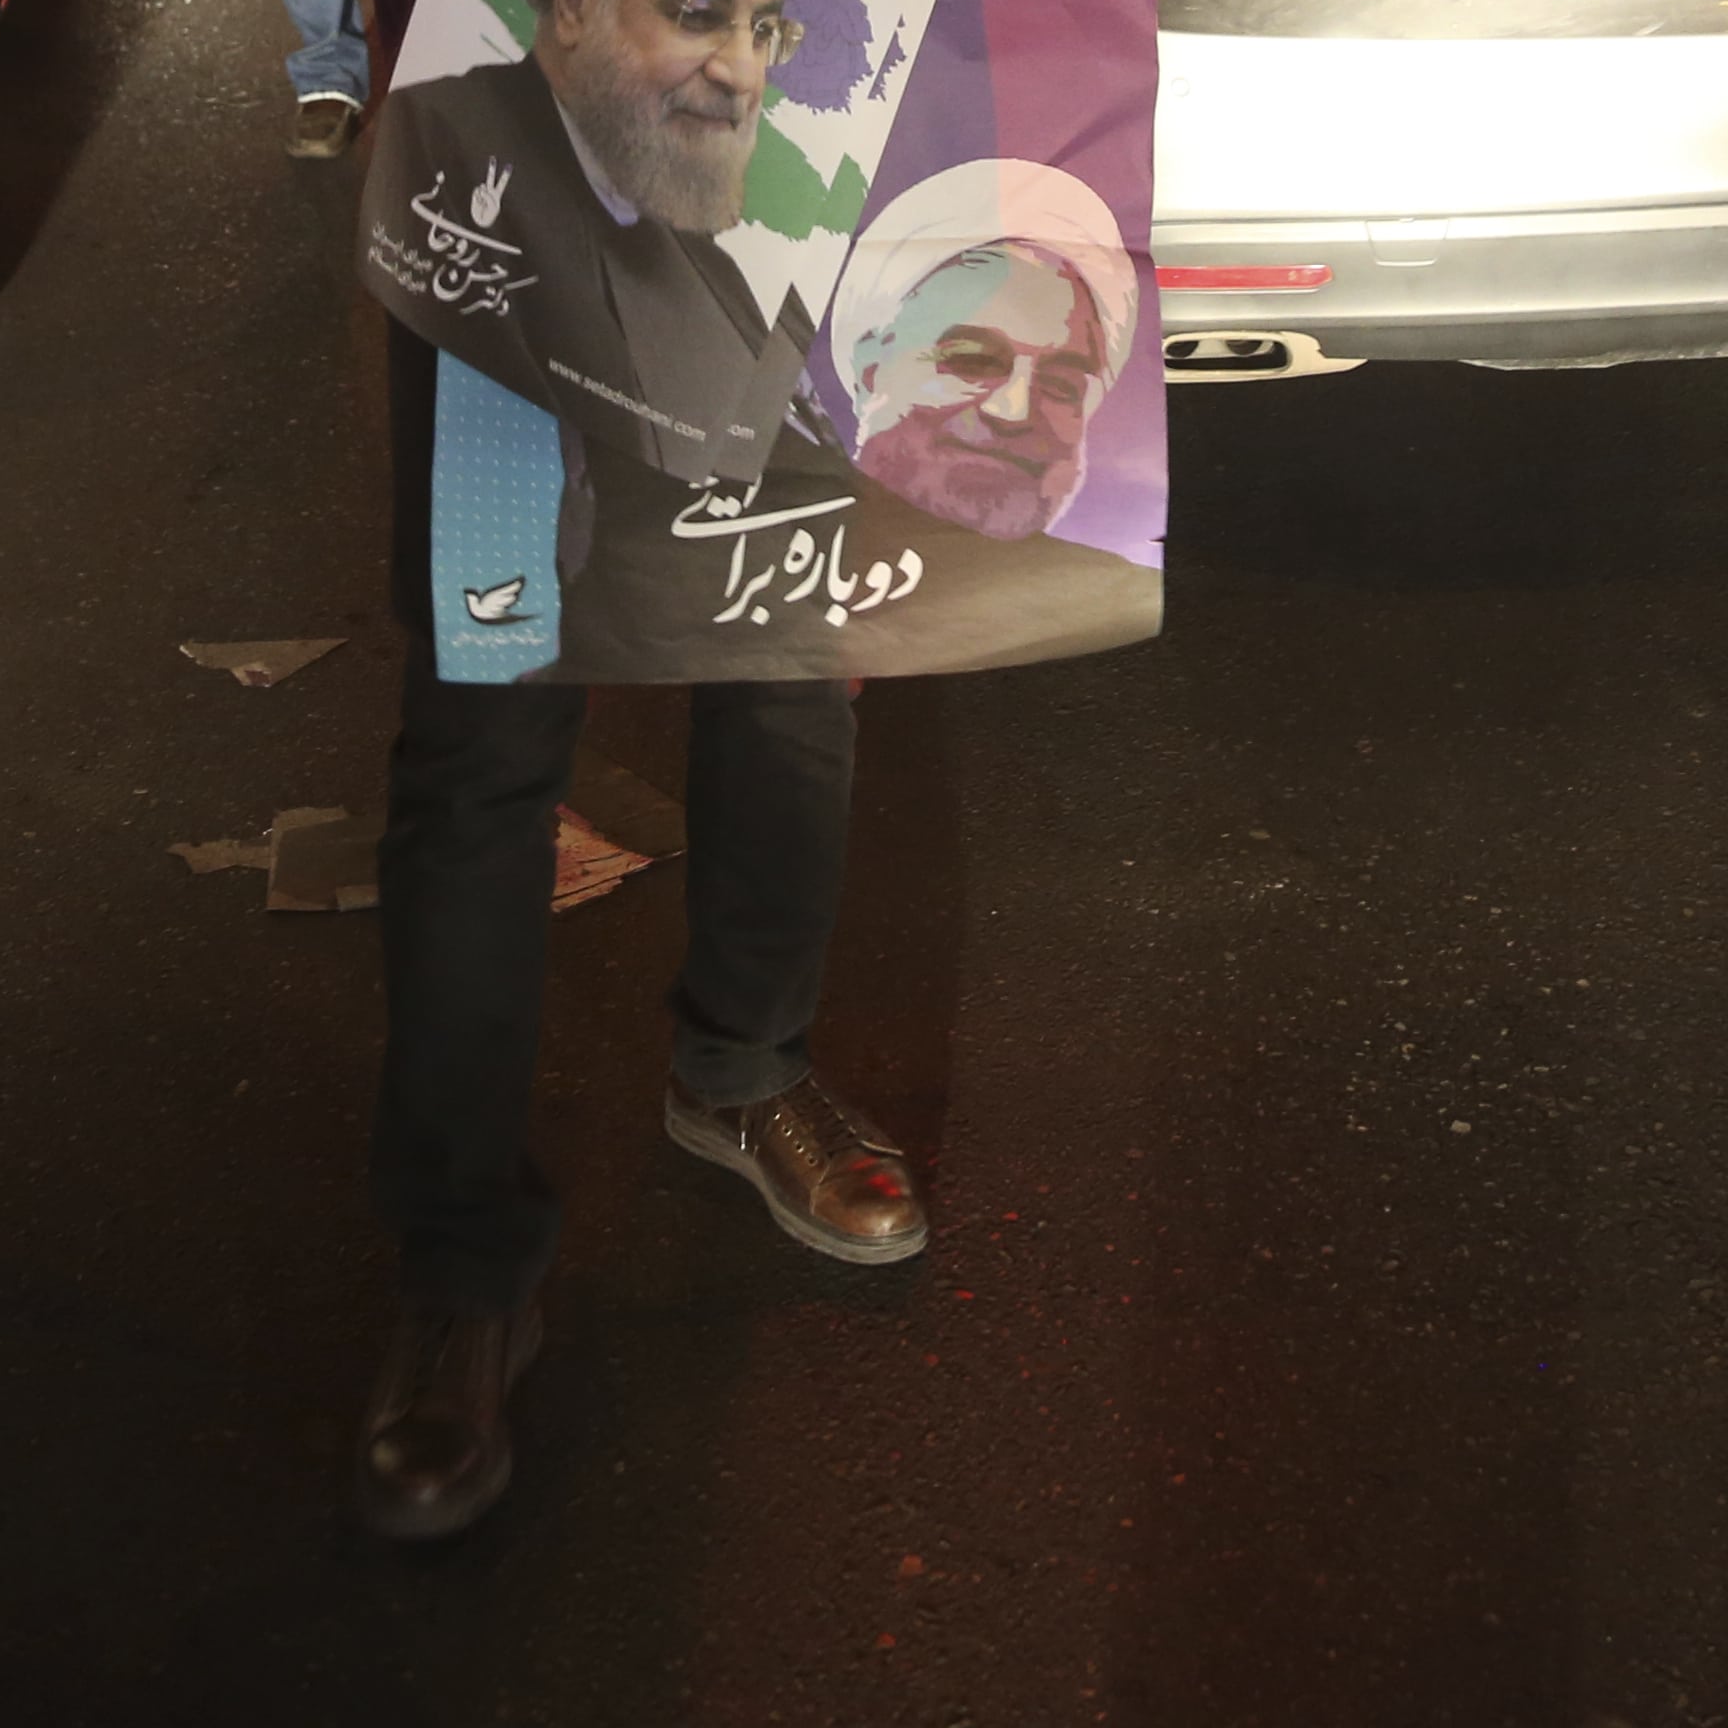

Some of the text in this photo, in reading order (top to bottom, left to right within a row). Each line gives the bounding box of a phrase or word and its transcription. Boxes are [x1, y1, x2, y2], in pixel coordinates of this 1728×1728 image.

[410, 170, 523, 268] روحانی
[433, 262, 509, 302] حسن
[783, 524, 924, 628] دوباره
